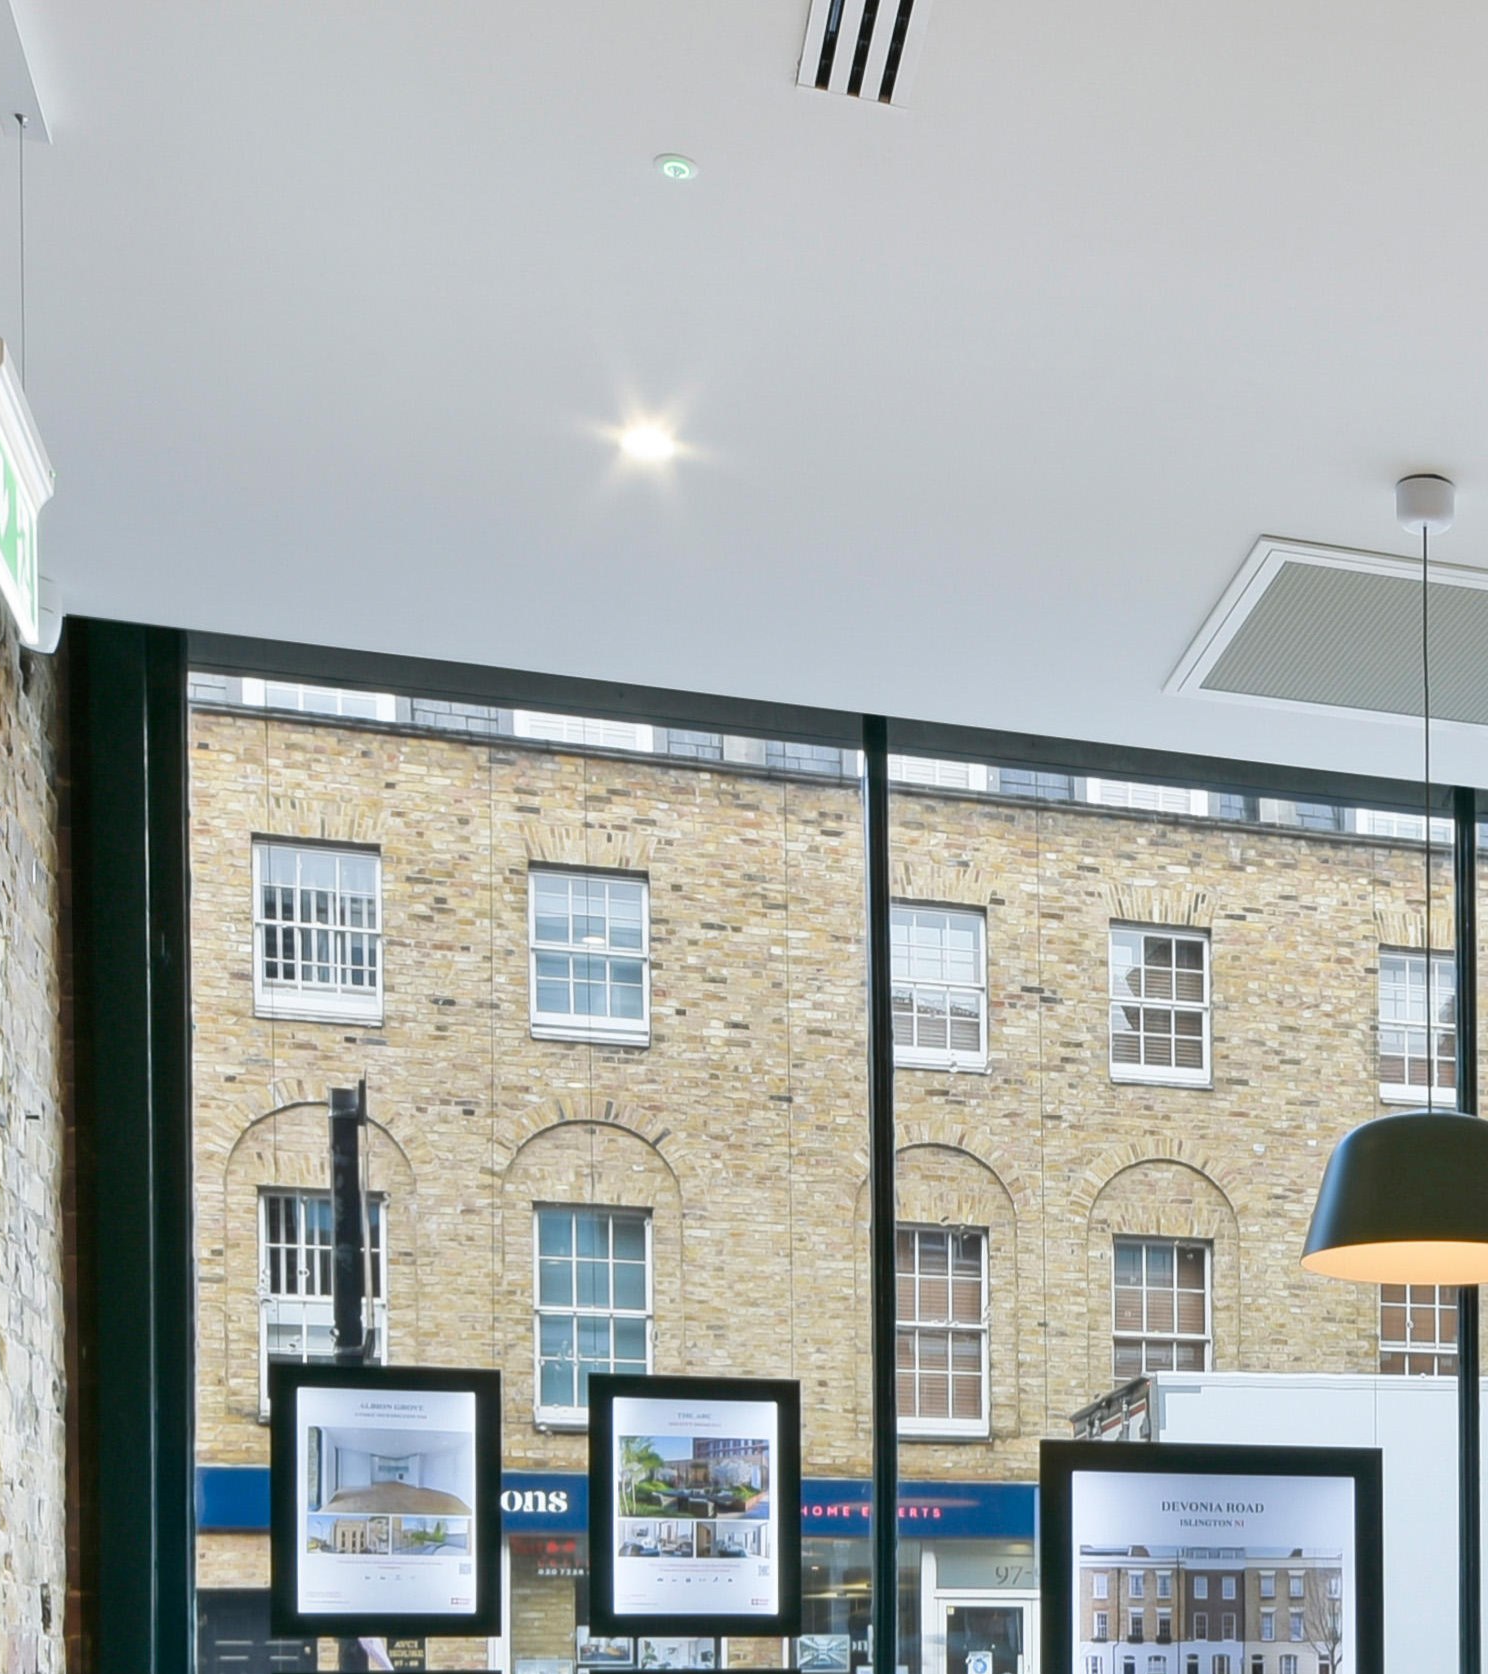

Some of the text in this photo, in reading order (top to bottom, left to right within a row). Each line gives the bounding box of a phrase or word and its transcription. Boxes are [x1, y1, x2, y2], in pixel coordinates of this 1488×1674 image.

[860, 1505, 942, 1518] EERTS
[1161, 1501, 1265, 1513] DEVONIA ROAD
[1179, 1518, 1232, 1528] ISLINGTON
